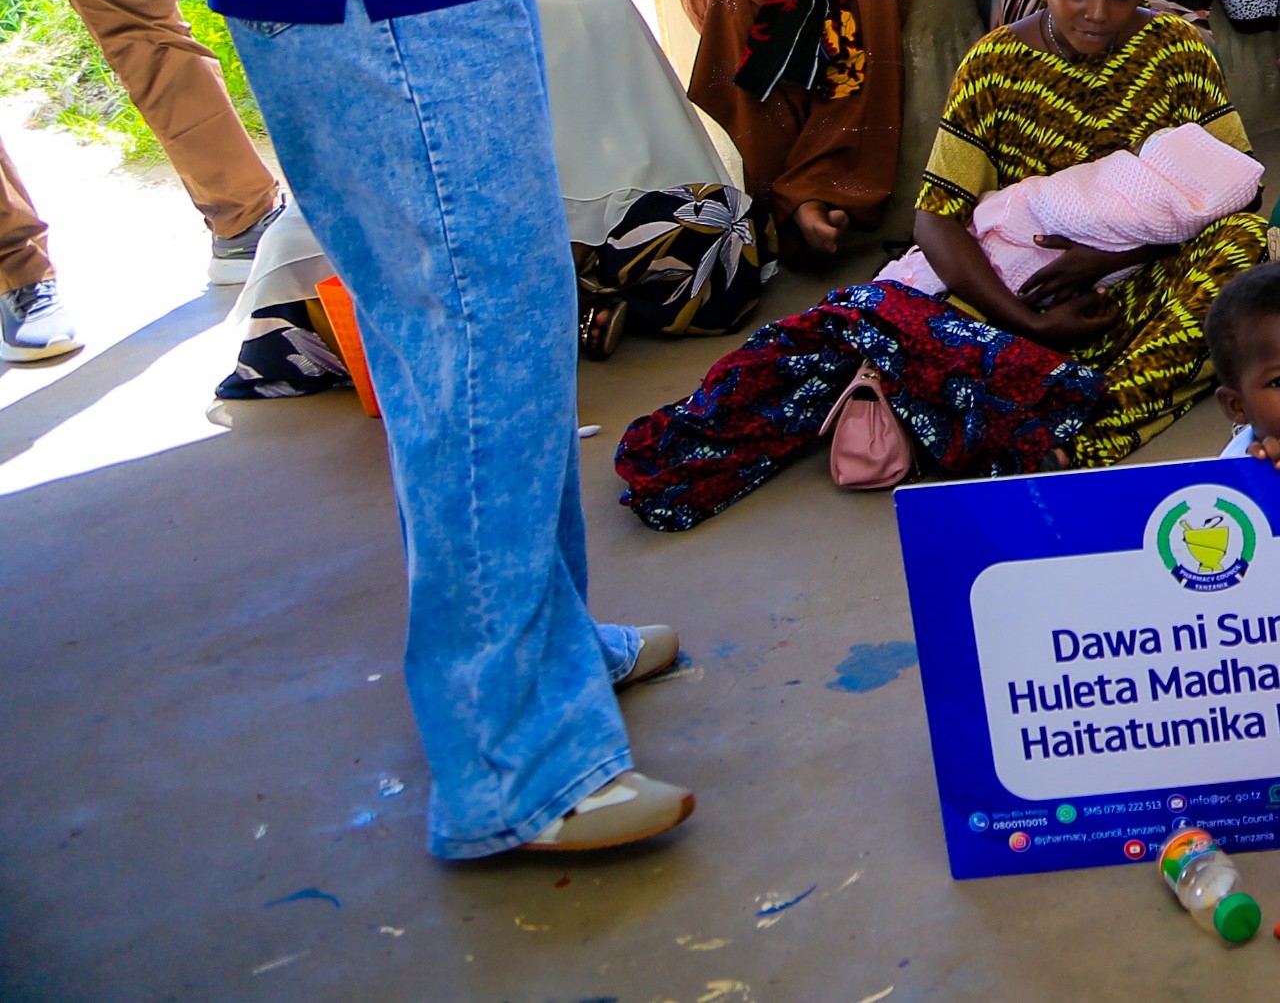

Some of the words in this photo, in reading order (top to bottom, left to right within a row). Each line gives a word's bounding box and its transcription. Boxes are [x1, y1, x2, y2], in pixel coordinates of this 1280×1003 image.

[1179, 569, 1215, 582] PHARMACY
[1195, 581, 1228, 591] TANZANIA
[1052, 626, 1162, 663] Dawa
[1172, 617, 1208, 652] ni
[1008, 671, 1139, 714] Huleta
[1020, 706, 1267, 760] Haitatumika
[1128, 802, 1144, 812] 222
[1146, 801, 1162, 811] 513
[993, 818, 1048, 830] 0800110015
[1196, 816, 1241, 829] Pharmacy
[1243, 813, 1274, 825] Council
[1034, 824, 1166, 846] @pharmacy_council_tanzania
[1234, 832, 1275, 843] Tanzania
